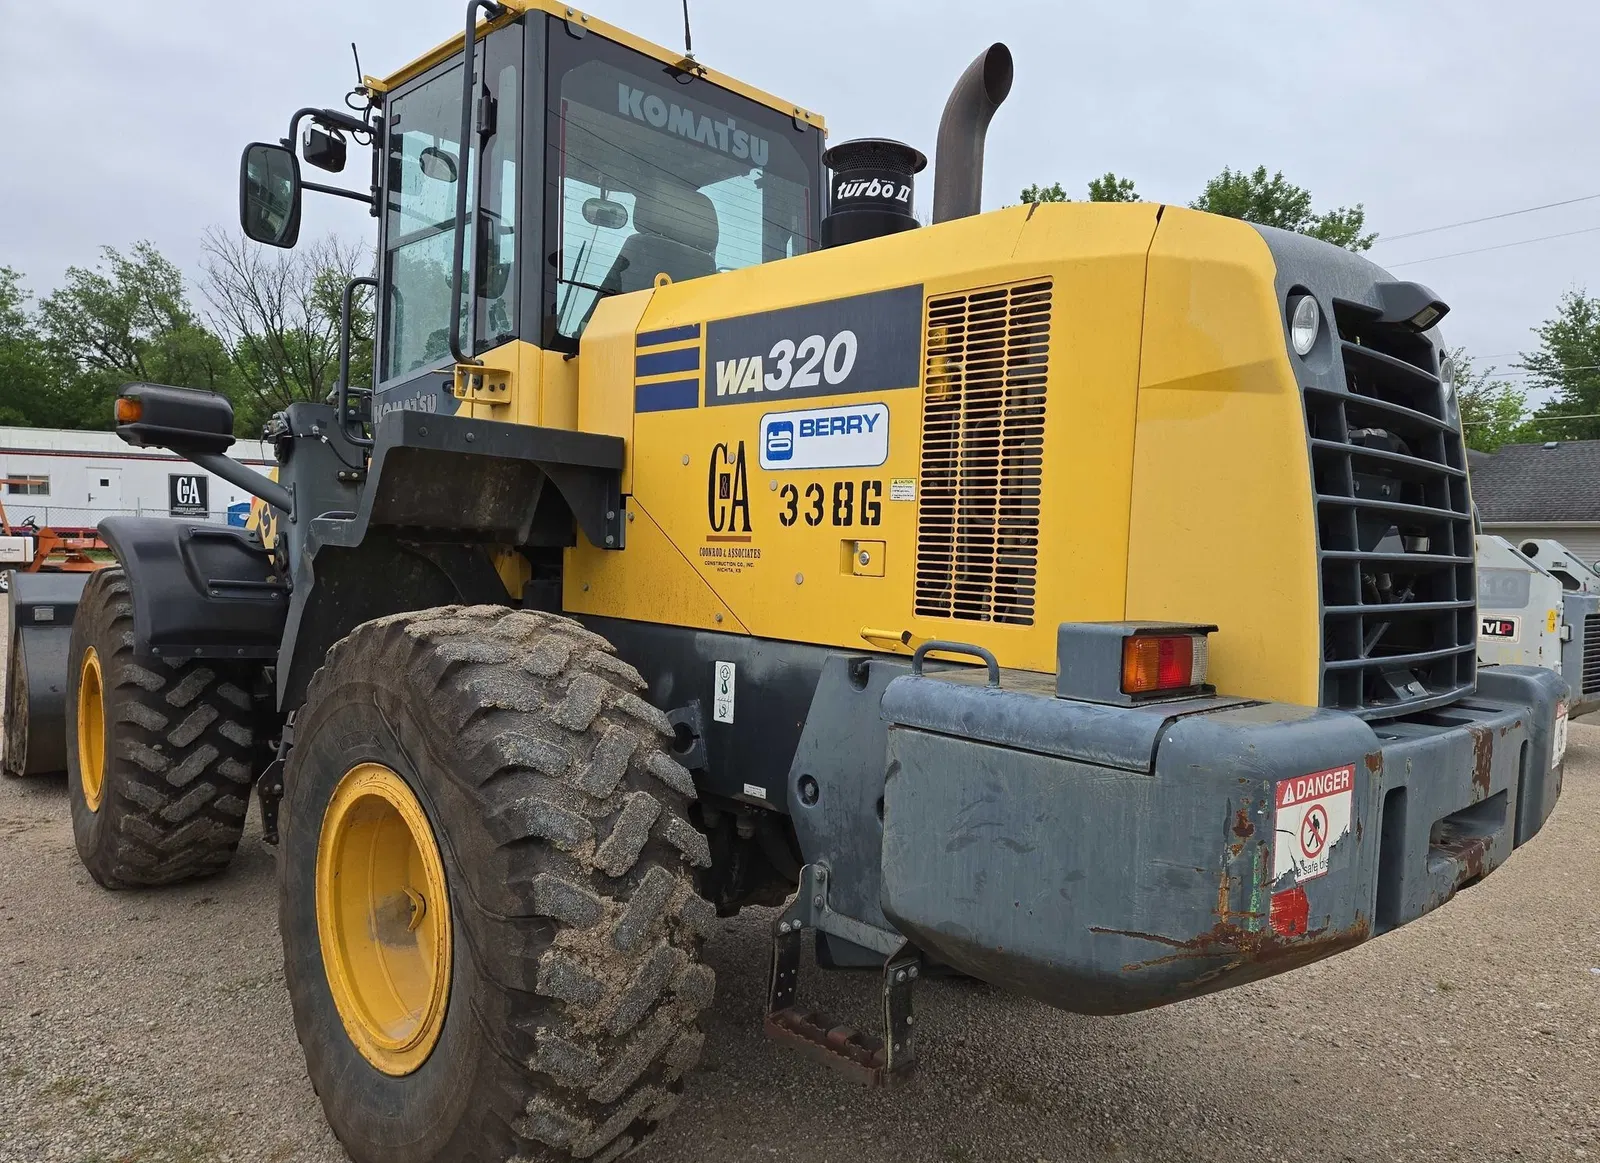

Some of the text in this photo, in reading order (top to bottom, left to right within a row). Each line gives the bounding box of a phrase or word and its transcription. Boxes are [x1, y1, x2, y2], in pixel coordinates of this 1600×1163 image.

[618, 82, 769, 167] KOMATSU
[837, 178, 894, 200] turbo
[716, 330, 858, 397] WA320
[800, 413, 880, 438] BERRY
[779, 480, 882, 527] 338G
[699, 547, 723, 557] COONROD
[728, 548, 761, 559] ASSOCIATES
[1296, 769, 1350, 801] DANGER
[1303, 860, 1319, 876] safe
